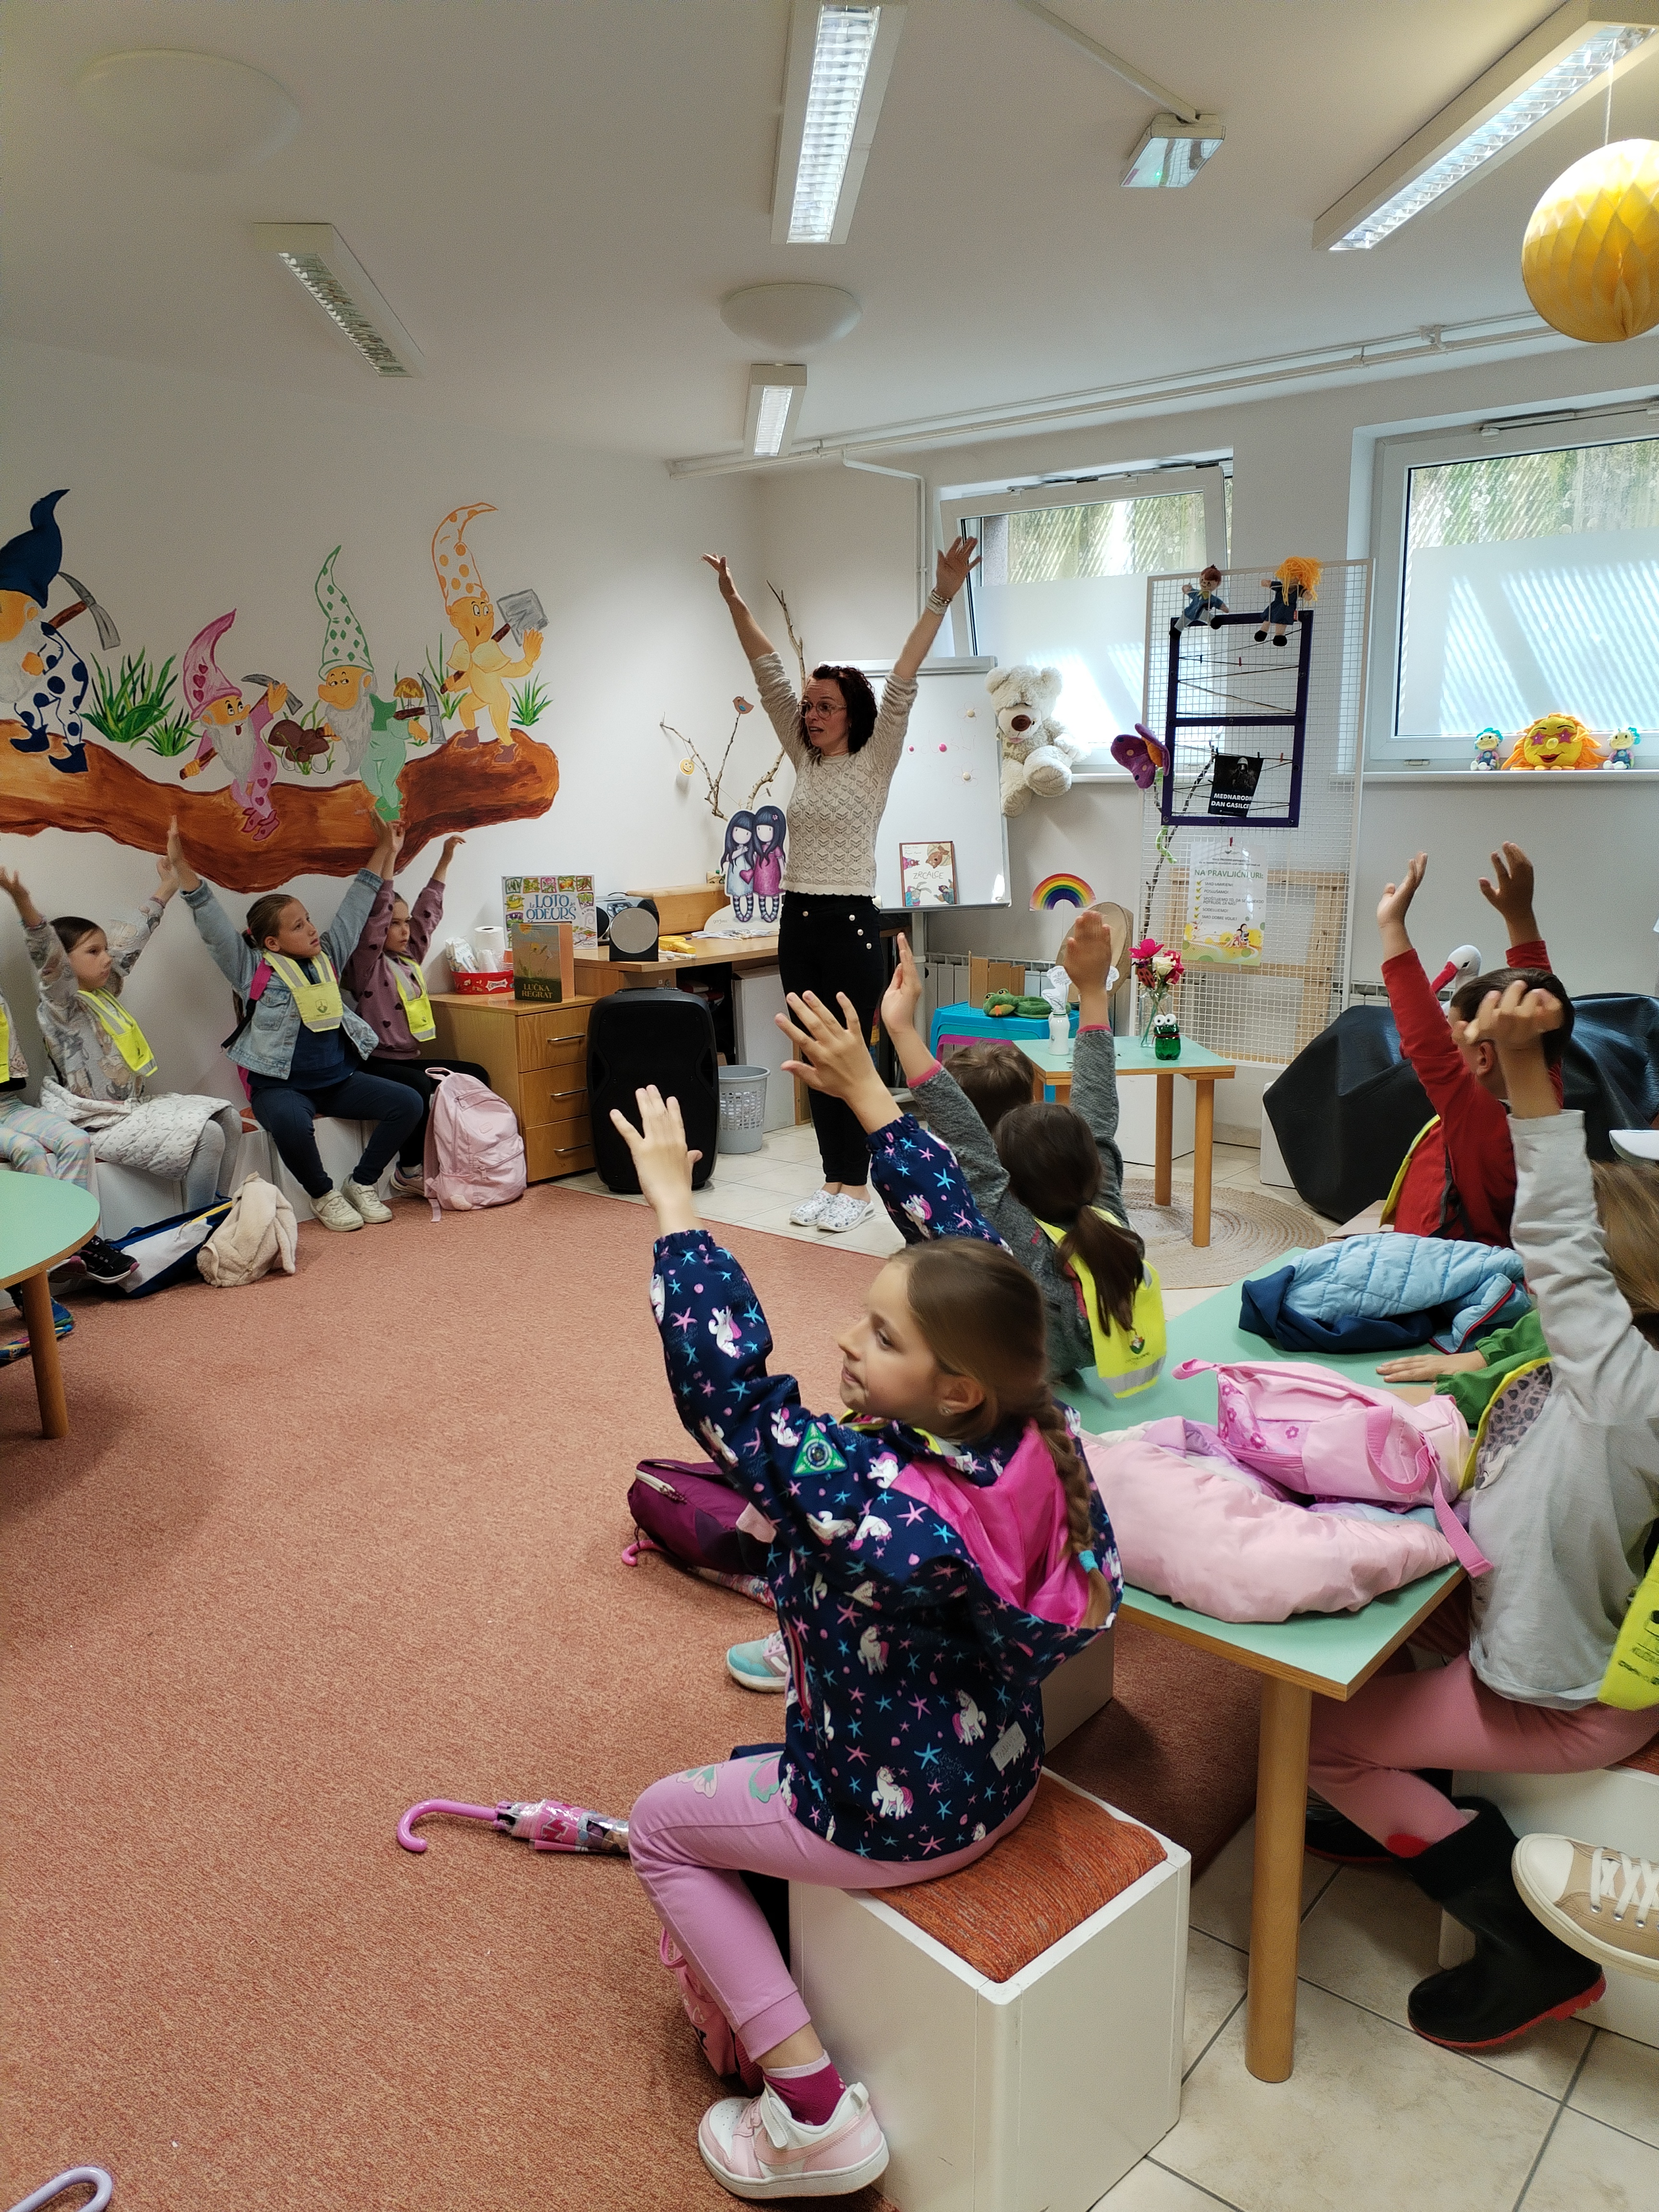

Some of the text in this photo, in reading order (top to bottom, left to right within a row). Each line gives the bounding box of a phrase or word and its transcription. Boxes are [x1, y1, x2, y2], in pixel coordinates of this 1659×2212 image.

[913, 871, 944, 879] ZRCALCE
[535, 894, 569, 908] LOTO
[526, 906, 576, 920] ODEURS
[524, 983, 550, 991] LUČKA
[522, 990, 553, 998] REGRAT
